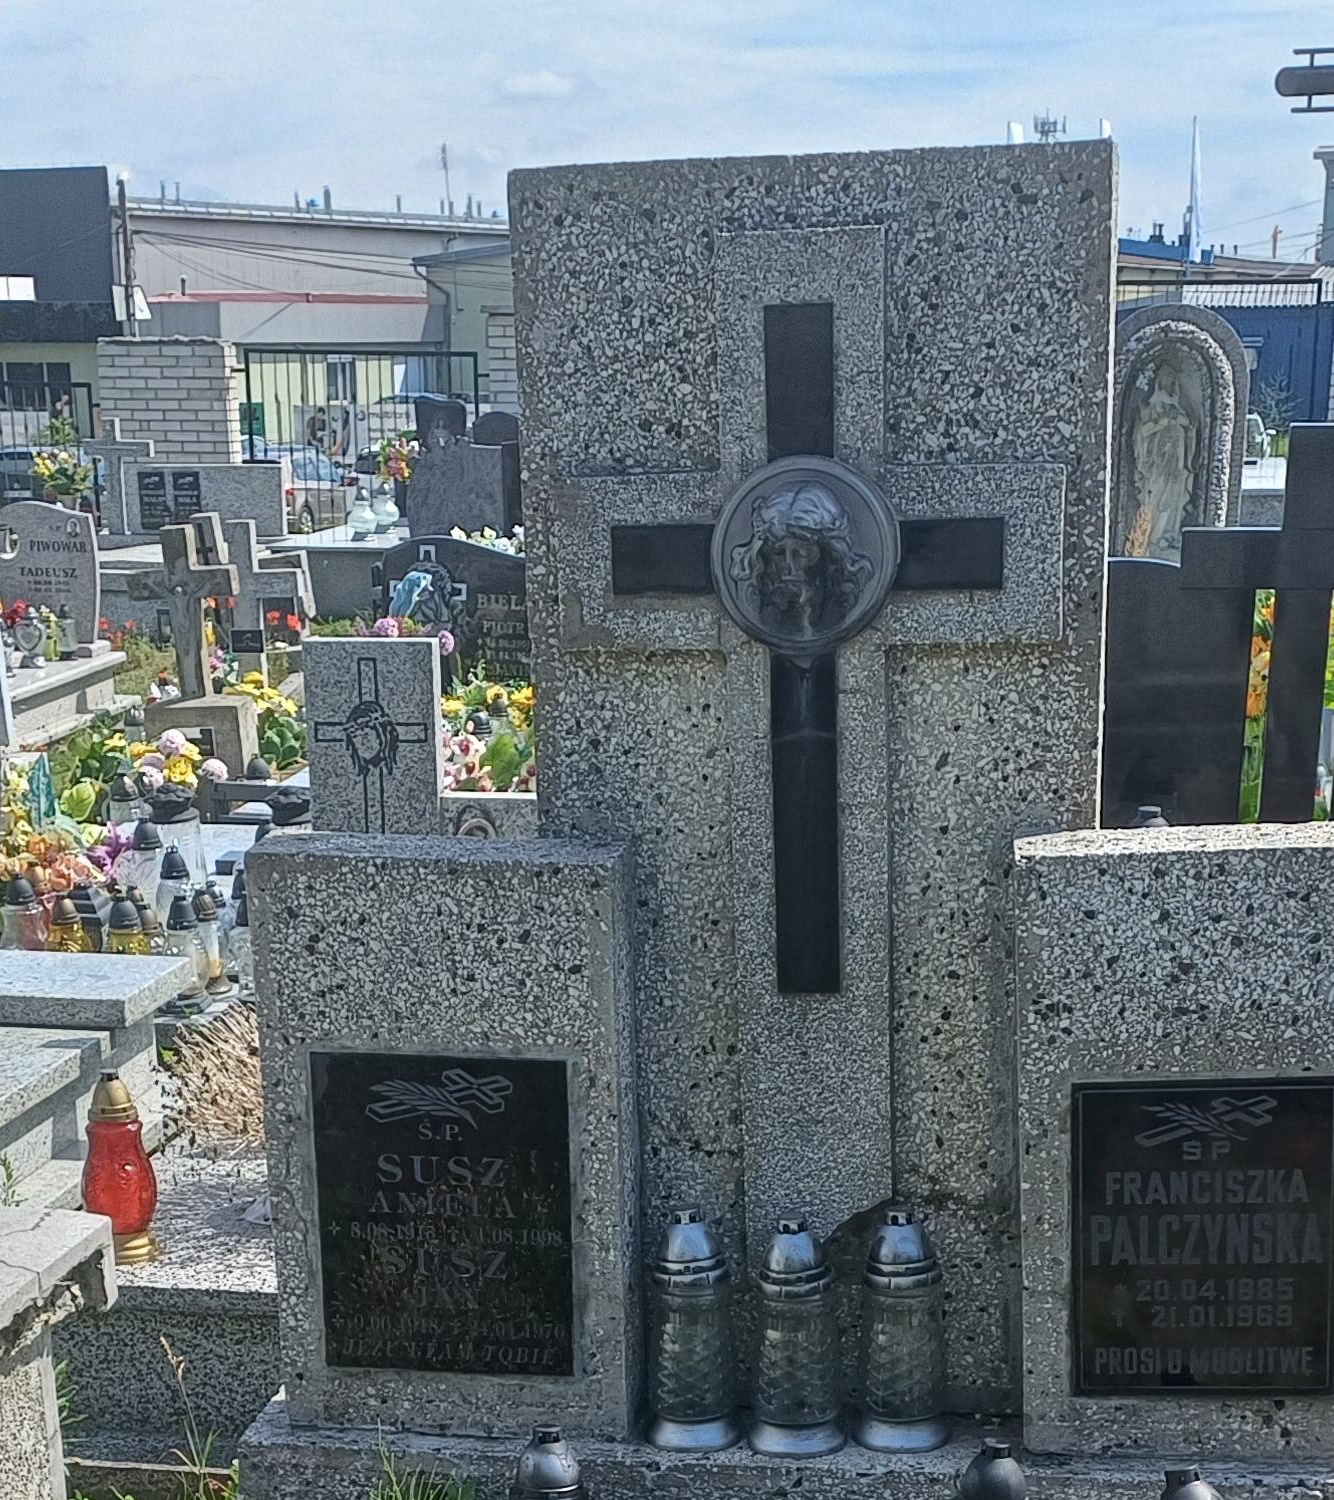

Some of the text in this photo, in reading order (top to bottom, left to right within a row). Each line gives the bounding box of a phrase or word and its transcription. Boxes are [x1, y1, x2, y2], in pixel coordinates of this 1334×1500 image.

[29, 539, 87, 553] PIWOWAR
[19, 566, 78, 579] TADEUSZ
[476, 593, 527, 611] BIEL
[481, 620, 525, 634] PIOTR
[377, 1153, 507, 1188] SUSZ
[1105, 1168, 1310, 1205] FRANCISZKA
[368, 1190, 518, 1219] ANIELA
[1136, 1277, 1294, 1301] 20.04.1885
[1150, 1303, 1294, 1328] 21.01.1969
[483, 1345, 555, 1365] TOBIE
[1094, 1346, 1161, 1376] PROSI
